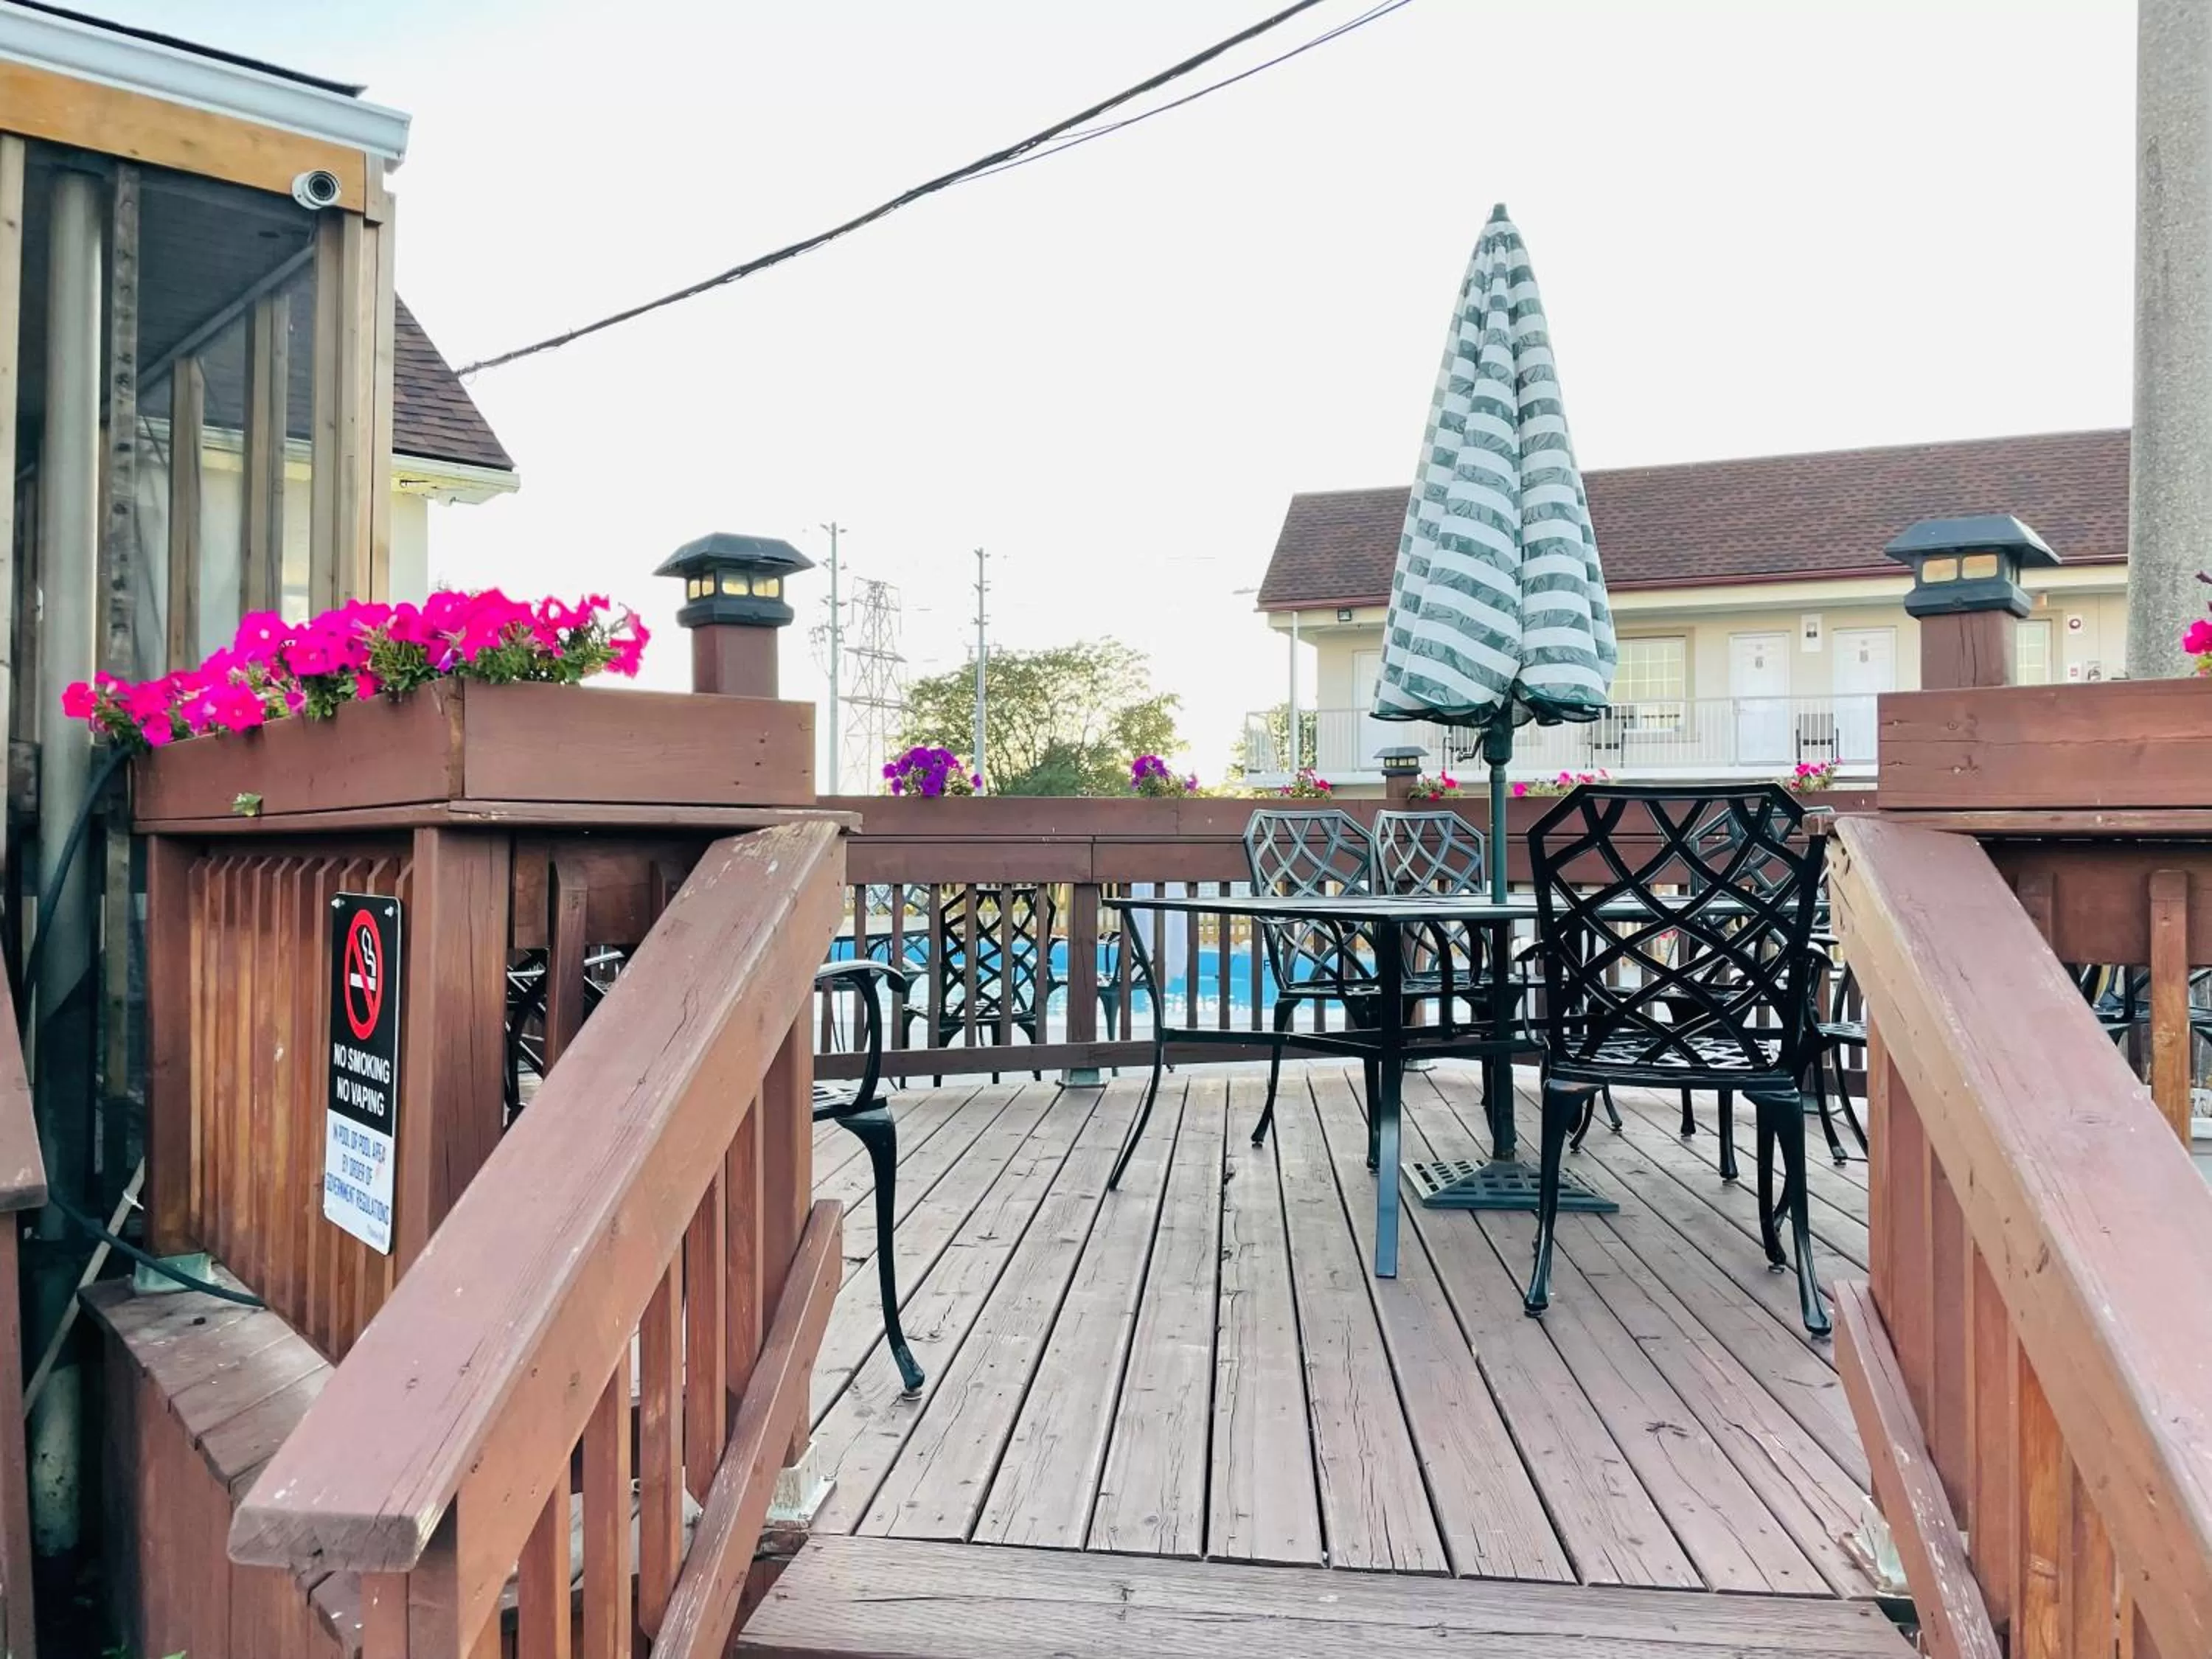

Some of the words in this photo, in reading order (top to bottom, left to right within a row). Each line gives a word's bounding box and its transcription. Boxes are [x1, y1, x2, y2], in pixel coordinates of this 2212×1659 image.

[334, 1042, 347, 1068] NO
[348, 1047, 390, 1085] SMOKING
[337, 1076, 349, 1102] NO
[351, 1082, 384, 1117] VAPING
[339, 1124, 349, 1147] POOL
[359, 1133, 370, 1158] POOL
[342, 1153, 348, 1172] BY
[349, 1158, 365, 1183] ORDER
[366, 1166, 372, 1186] OF
[326, 1171, 355, 1203] GOVERNMENT
[356, 1189, 389, 1226] REGULATIONS
